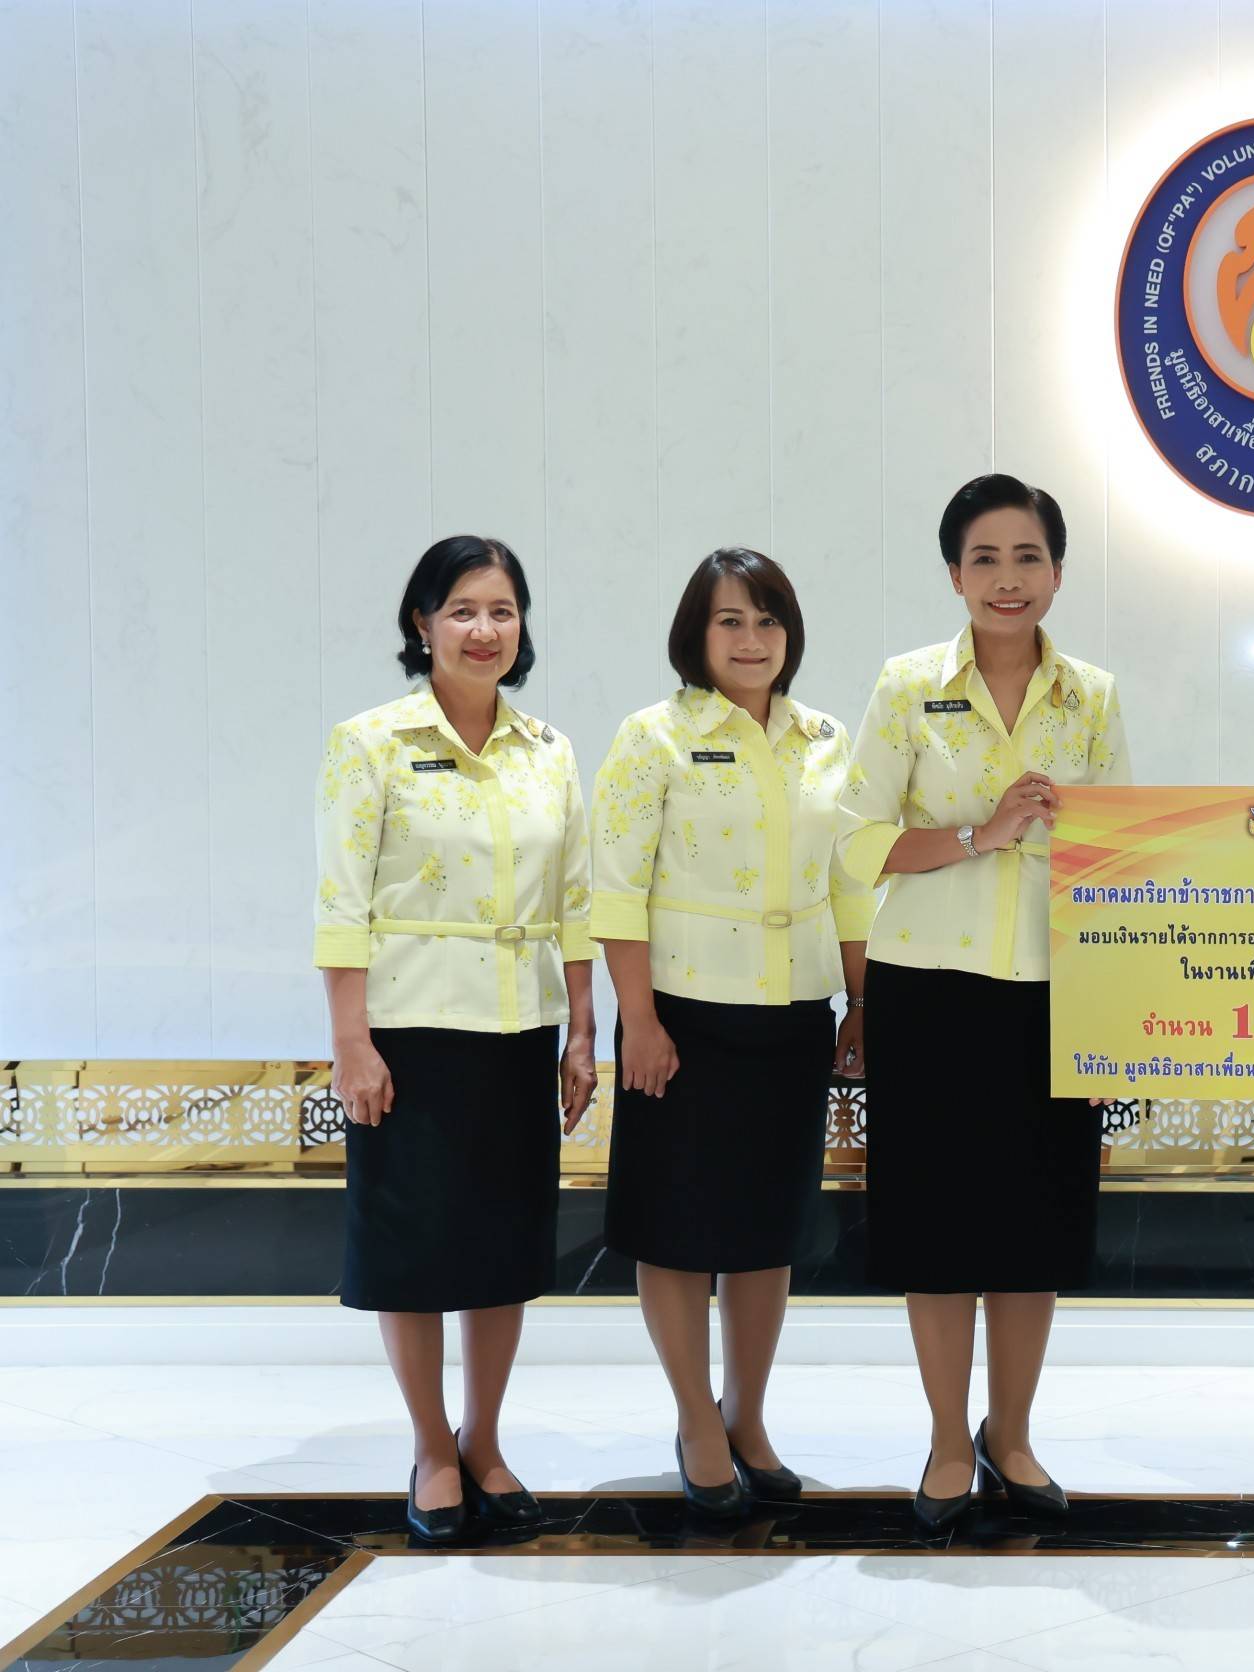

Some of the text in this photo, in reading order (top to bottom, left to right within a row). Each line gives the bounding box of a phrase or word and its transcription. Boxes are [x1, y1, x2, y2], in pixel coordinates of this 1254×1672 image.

[1144, 258, 1165, 308] NEED
[1143, 316, 1158, 334] IN
[1144, 341, 1176, 420] FRIENDS
[1142, 1011, 1213, 1037] จำนวน
[1073, 1052, 1119, 1077] ให้กับ
